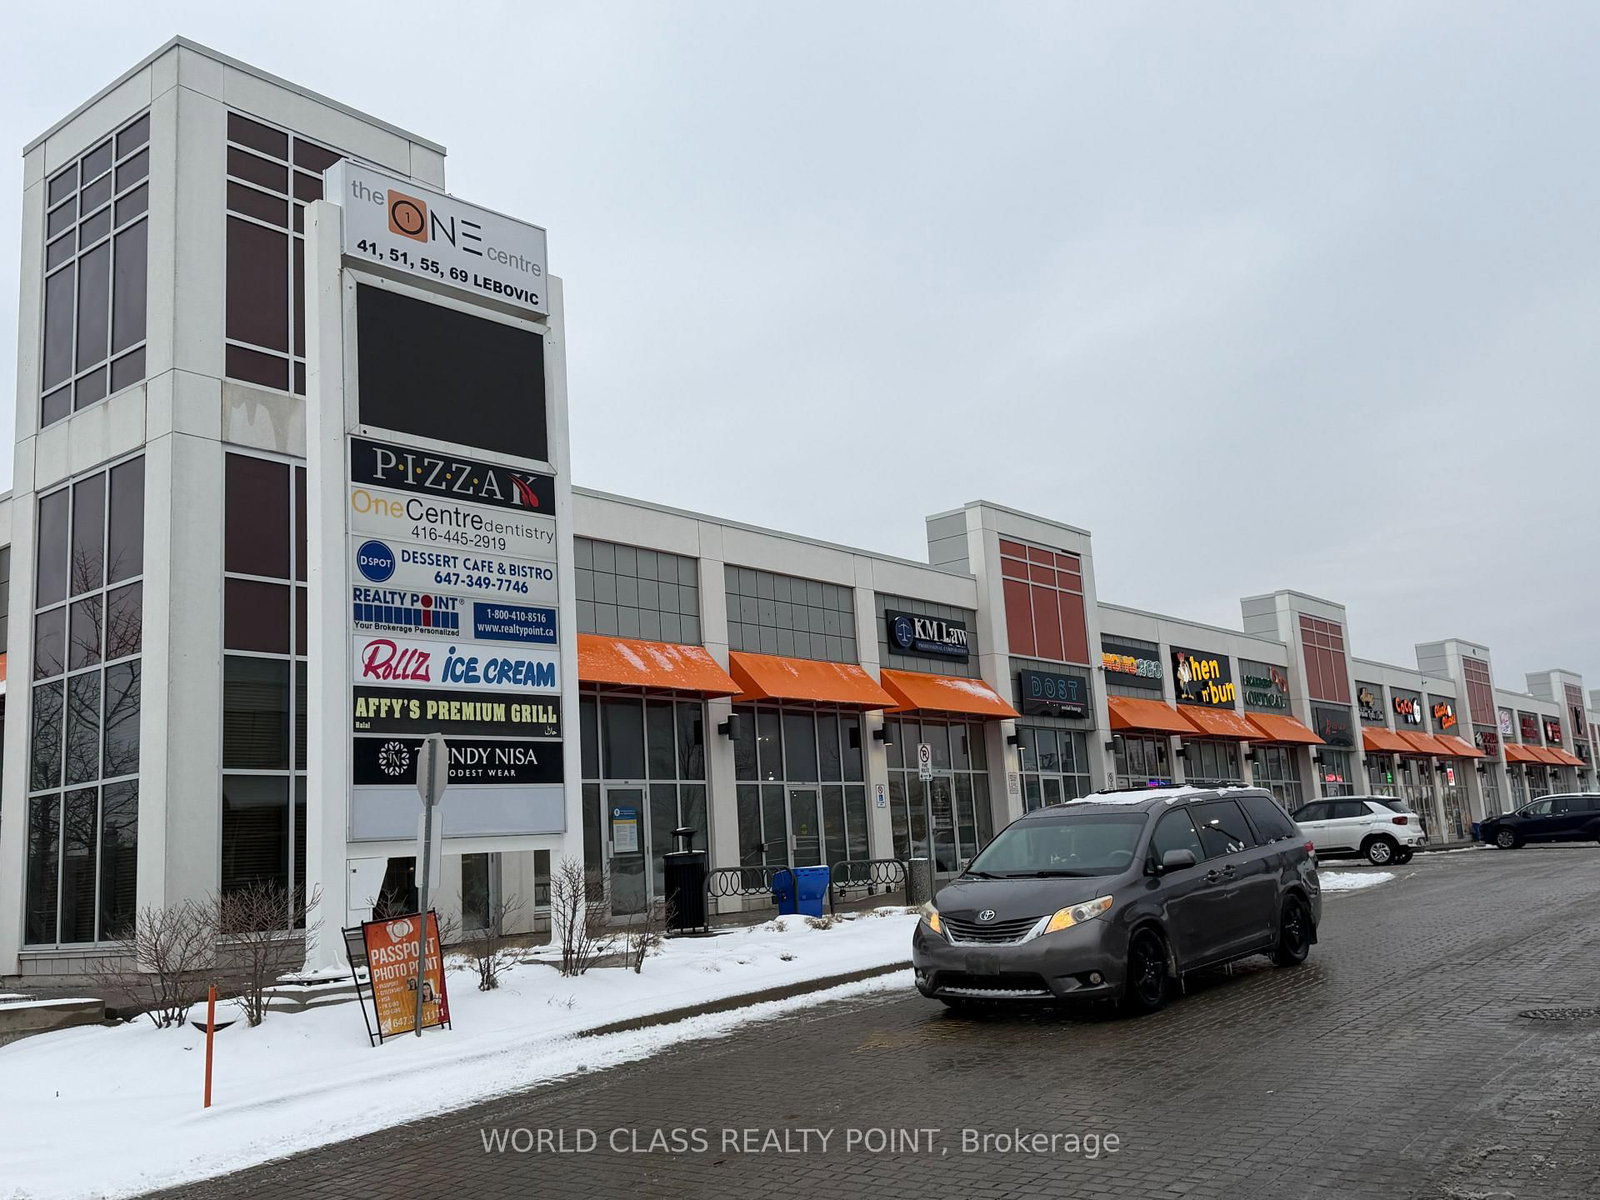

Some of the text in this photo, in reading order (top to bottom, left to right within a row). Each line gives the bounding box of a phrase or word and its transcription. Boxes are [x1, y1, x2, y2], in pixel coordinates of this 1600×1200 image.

[351, 179, 385, 206] the
[486, 246, 542, 277] centre
[357, 238, 540, 306] 41, 51, 55, 69 LEBOVIC
[411, 525, 507, 551] 416-445-2919
[401, 549, 553, 581] DESSERT CAFE & BISTRO
[434, 571, 529, 594] 647-349-7746
[353, 587, 407, 606] REALTY
[486, 608, 547, 624] 1-800-410-8516
[354, 621, 460, 637] Your Brokerage Personalized
[477, 623, 554, 638] www.realtypoint.ca
[913, 617, 968, 646] KM Law
[483, 657, 556, 688] CREAM
[1190, 655, 1220, 681] hen
[1031, 675, 1078, 701] DOST
[1209, 680, 1237, 704] bun
[355, 697, 558, 723] AFFY'S PREMIUM GRILL
[495, 747, 538, 765] NISA
[448, 769, 516, 777] ODEST WEAR
[373, 963, 407, 983] PHOTO
